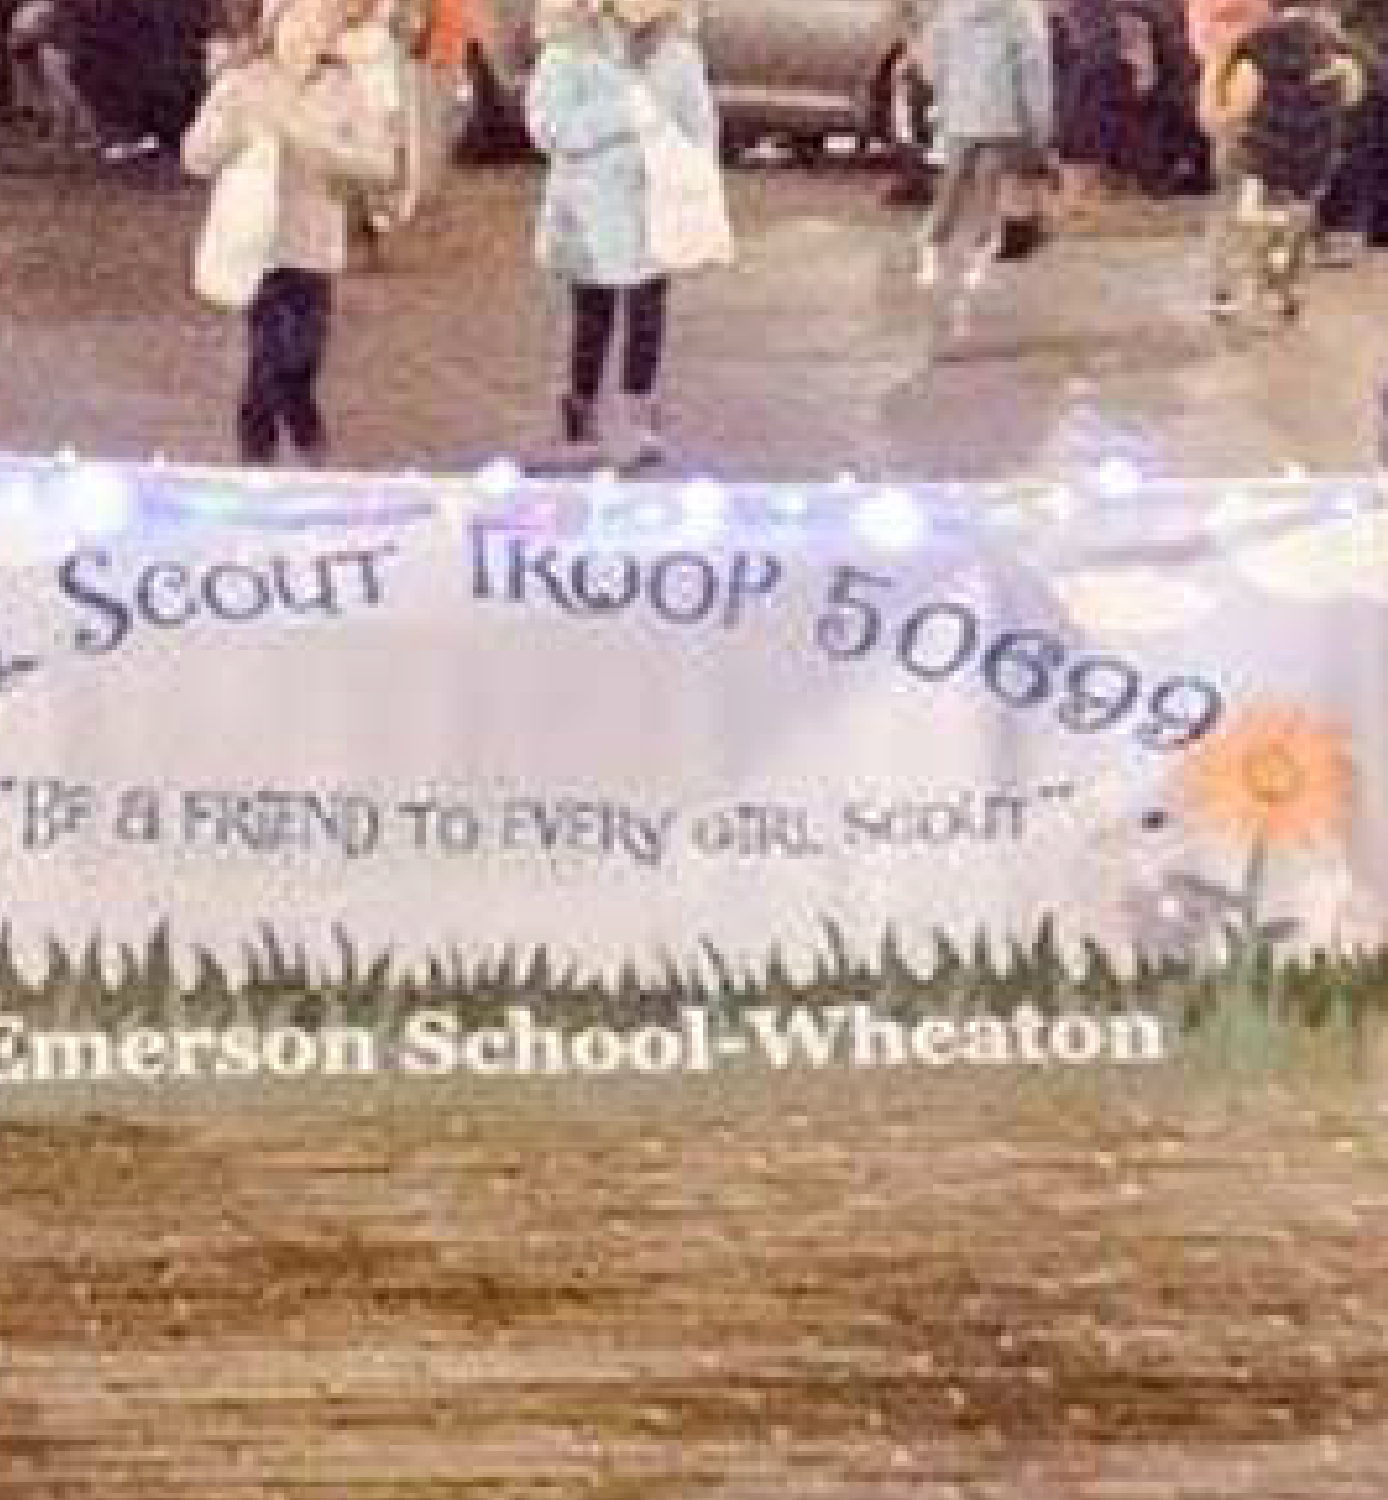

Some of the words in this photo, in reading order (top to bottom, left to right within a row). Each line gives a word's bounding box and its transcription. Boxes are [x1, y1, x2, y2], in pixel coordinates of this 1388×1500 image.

[816, 565, 1221, 750] 50699
[181, 790, 381, 858] FRIEND
[405, 1002, 1165, 1074] School-Wheaton
